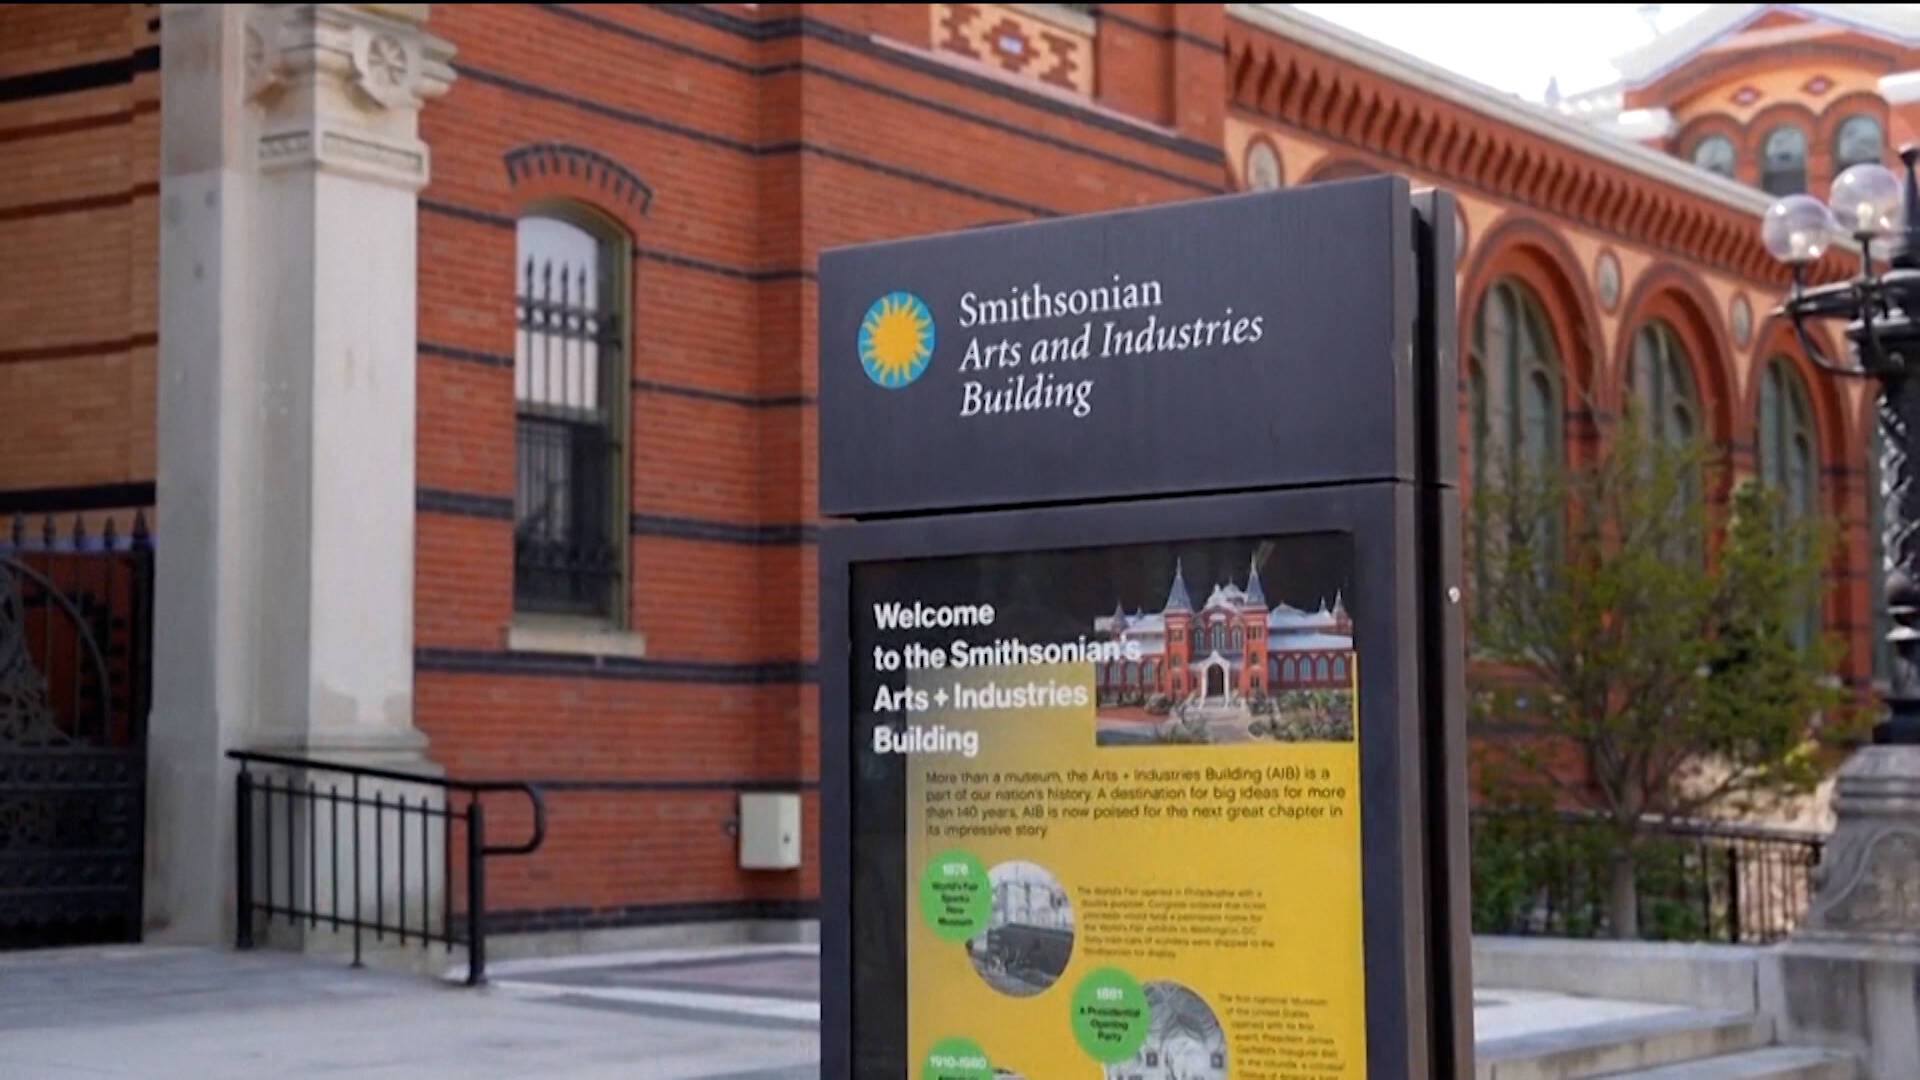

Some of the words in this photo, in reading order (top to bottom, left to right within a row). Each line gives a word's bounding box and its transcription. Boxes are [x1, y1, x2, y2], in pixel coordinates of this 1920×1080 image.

[959, 274, 1163, 328] Smithsonian
[959, 336, 1022, 372] Arts
[1030, 322, 1090, 361] and
[1100, 308, 1264, 358] Industries
[960, 375, 1093, 417] Building
[874, 601, 995, 630] Welcome
[874, 645, 900, 670] to
[906, 642, 947, 669] the
[951, 635, 1141, 668] Smithsonian's
[874, 685, 929, 712] Arts
[934, 691, 949, 708] +
[954, 681, 1088, 710] Industries
[873, 724, 980, 756] Building
[926, 772, 956, 784] More
[962, 772, 988, 783] than
[993, 773, 1000, 783] a
[1067, 771, 1088, 783] the
[1092, 769, 1118, 782] Arts
[1134, 768, 1200, 781] Industries
[1206, 767, 1262, 783] Building
[1267, 767, 1300, 780] (AIB)
[1305, 768, 1316, 779] is
[1321, 769, 1329, 779] a
[926, 789, 951, 802] part
[955, 788, 967, 800] of
[971, 790, 990, 800] our
[1098, 788, 1106, 799] A
[1110, 787, 1186, 800] destination
[1190, 787, 1208, 799] for
[1213, 787, 1235, 802] big
[1240, 786, 1278, 799] ideas
[1284, 786, 1301, 798] for
[1308, 787, 1345, 798] more
[1048, 806, 1058, 818] is
[1062, 807, 1088, 818] now
[1143, 805, 1161, 816] for
[1166, 805, 1188, 817] the
[1193, 806, 1222, 817] next
[1227, 805, 1263, 821] great
[1269, 804, 1325, 819] chapter
[1330, 805, 1343, 816] in
[944, 824, 1010, 838] impressive
